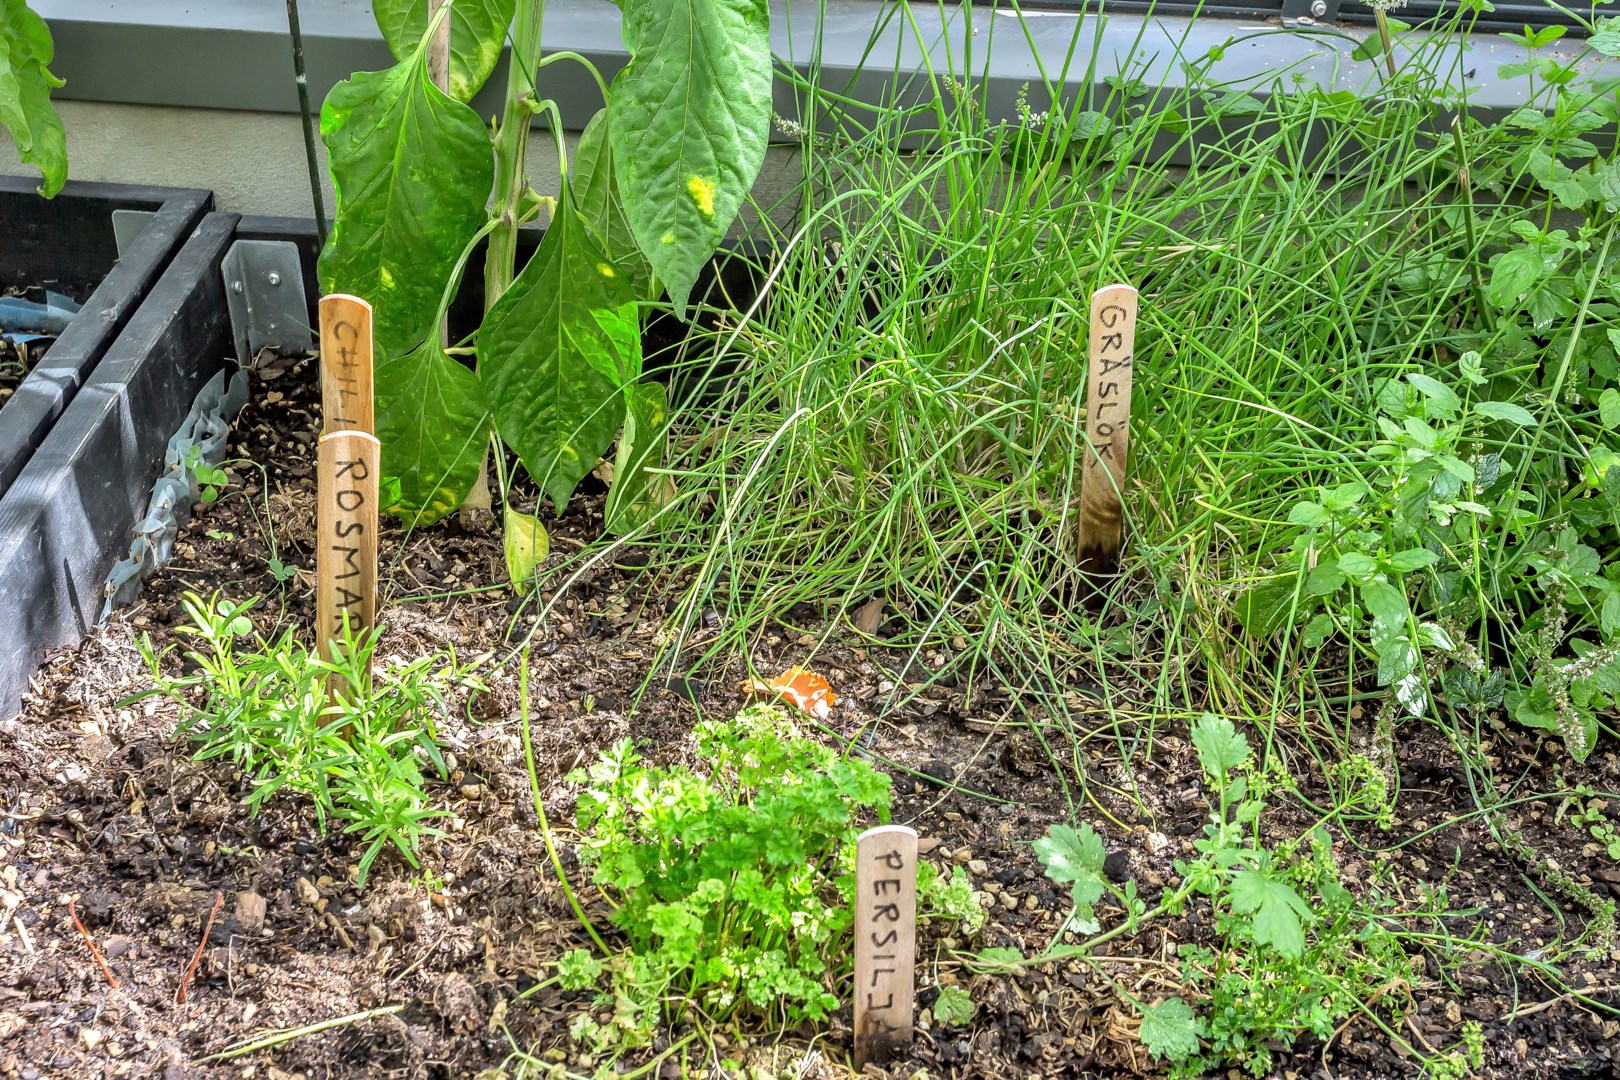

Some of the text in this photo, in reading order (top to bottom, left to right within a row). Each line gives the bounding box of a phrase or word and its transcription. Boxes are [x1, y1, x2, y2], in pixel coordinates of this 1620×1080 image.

[332, 320, 359, 424] CHILI
[1090, 304, 1132, 468] GRÄSLÖK
[332, 457, 368, 664] ROSMAR
